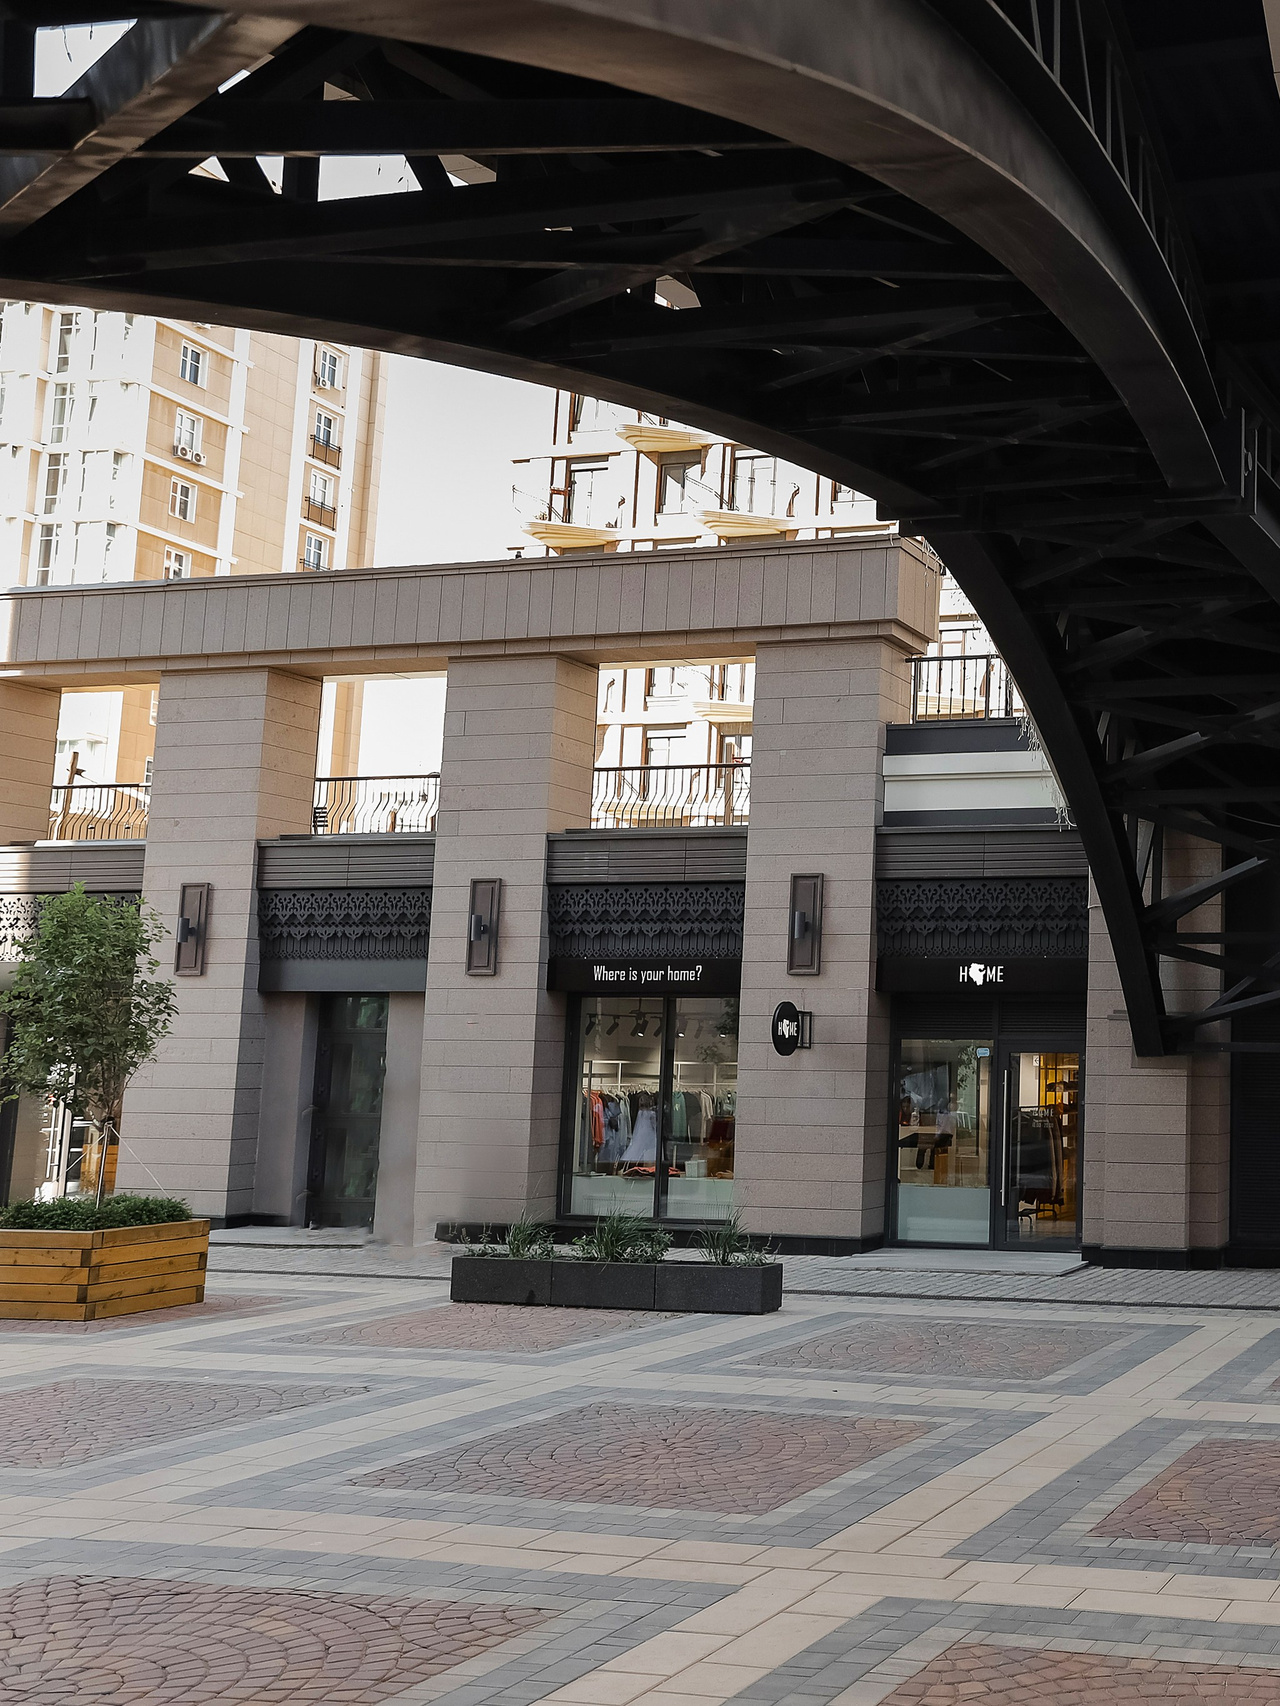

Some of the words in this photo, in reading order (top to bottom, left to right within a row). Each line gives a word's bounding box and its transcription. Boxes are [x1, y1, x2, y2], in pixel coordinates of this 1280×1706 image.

[593, 965, 626, 981] Where
[629, 967, 638, 981] is
[640, 970, 665, 984] your
[667, 965, 703, 981] home?
